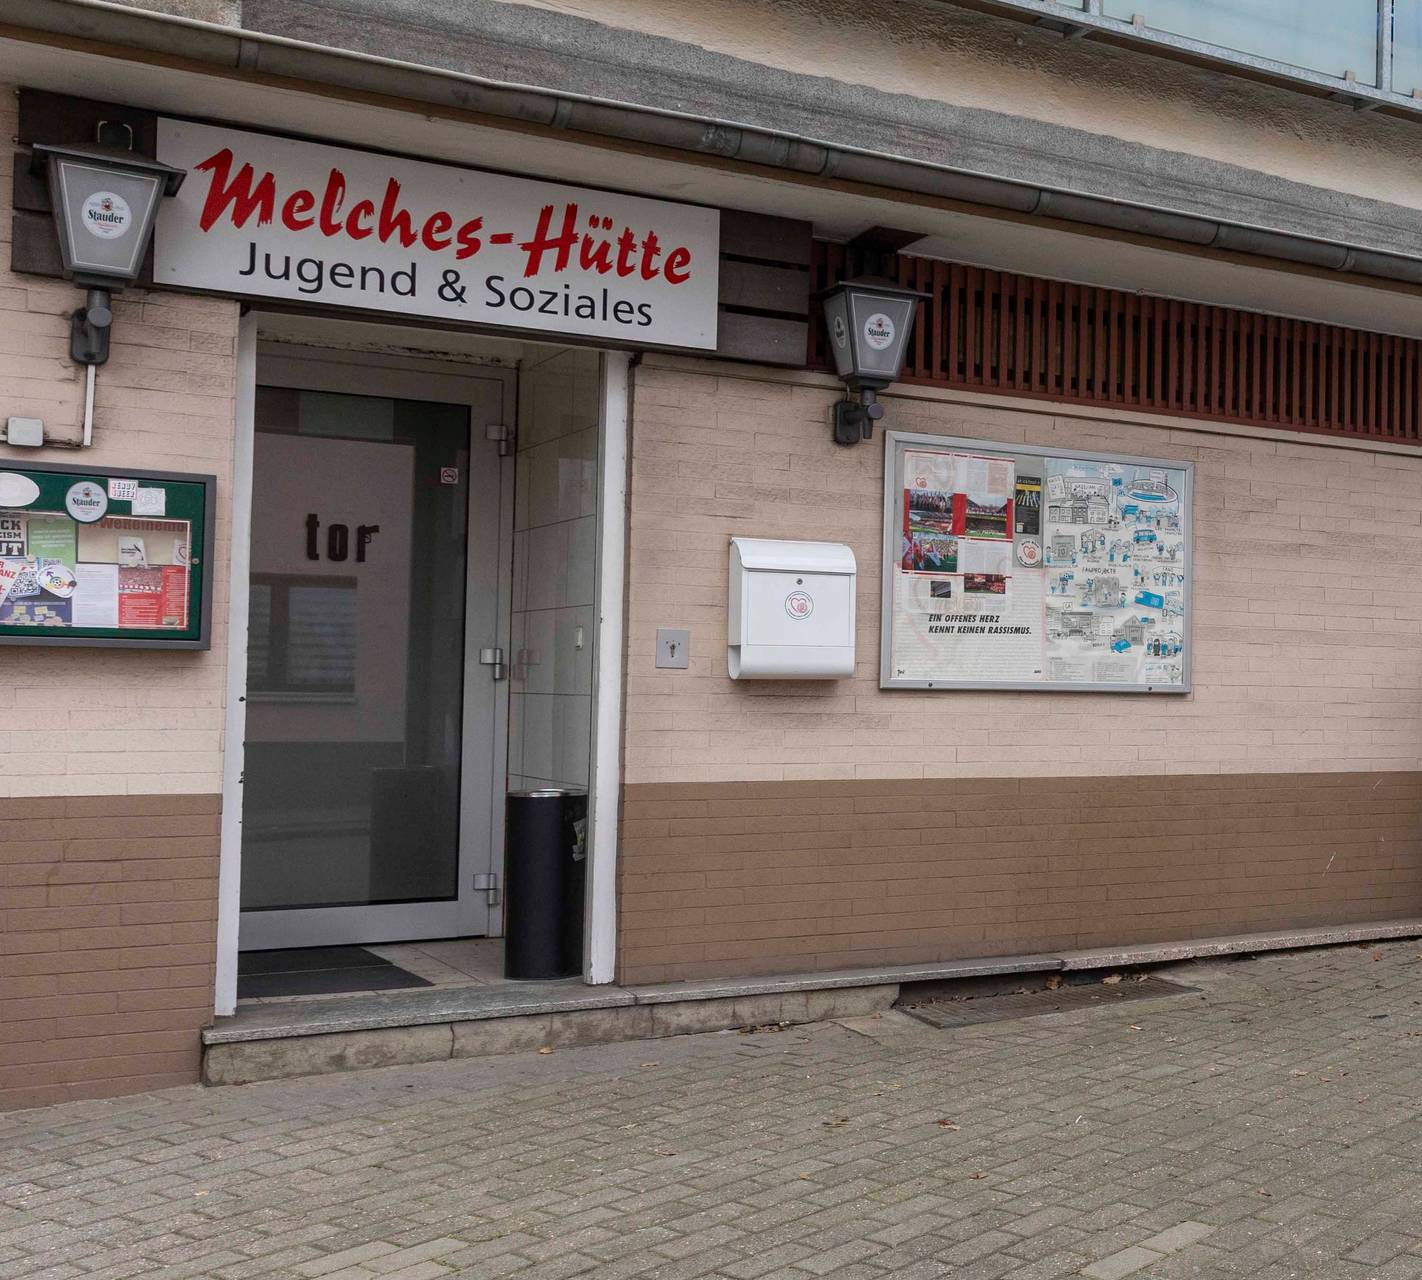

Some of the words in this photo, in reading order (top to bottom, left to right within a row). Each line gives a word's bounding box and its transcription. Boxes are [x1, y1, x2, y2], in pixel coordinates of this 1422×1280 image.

[88, 209, 124, 223] Stauder
[194, 147, 692, 285] Melches-Hütte
[239, 242, 417, 297] Jugend
[437, 269, 467, 304] &
[485, 276, 653, 326] Soziales
[867, 327, 890, 337] Stauder
[72, 497, 101, 507] Stauder
[305, 513, 380, 563] tor
[928, 614, 942, 623] EIN
[945, 614, 977, 623] OFFENES
[979, 615, 1000, 623] HERZ
[928, 626, 955, 634] KENNT
[957, 626, 986, 634] KEINEN
[987, 626, 1032, 635] RASSISMUS.
